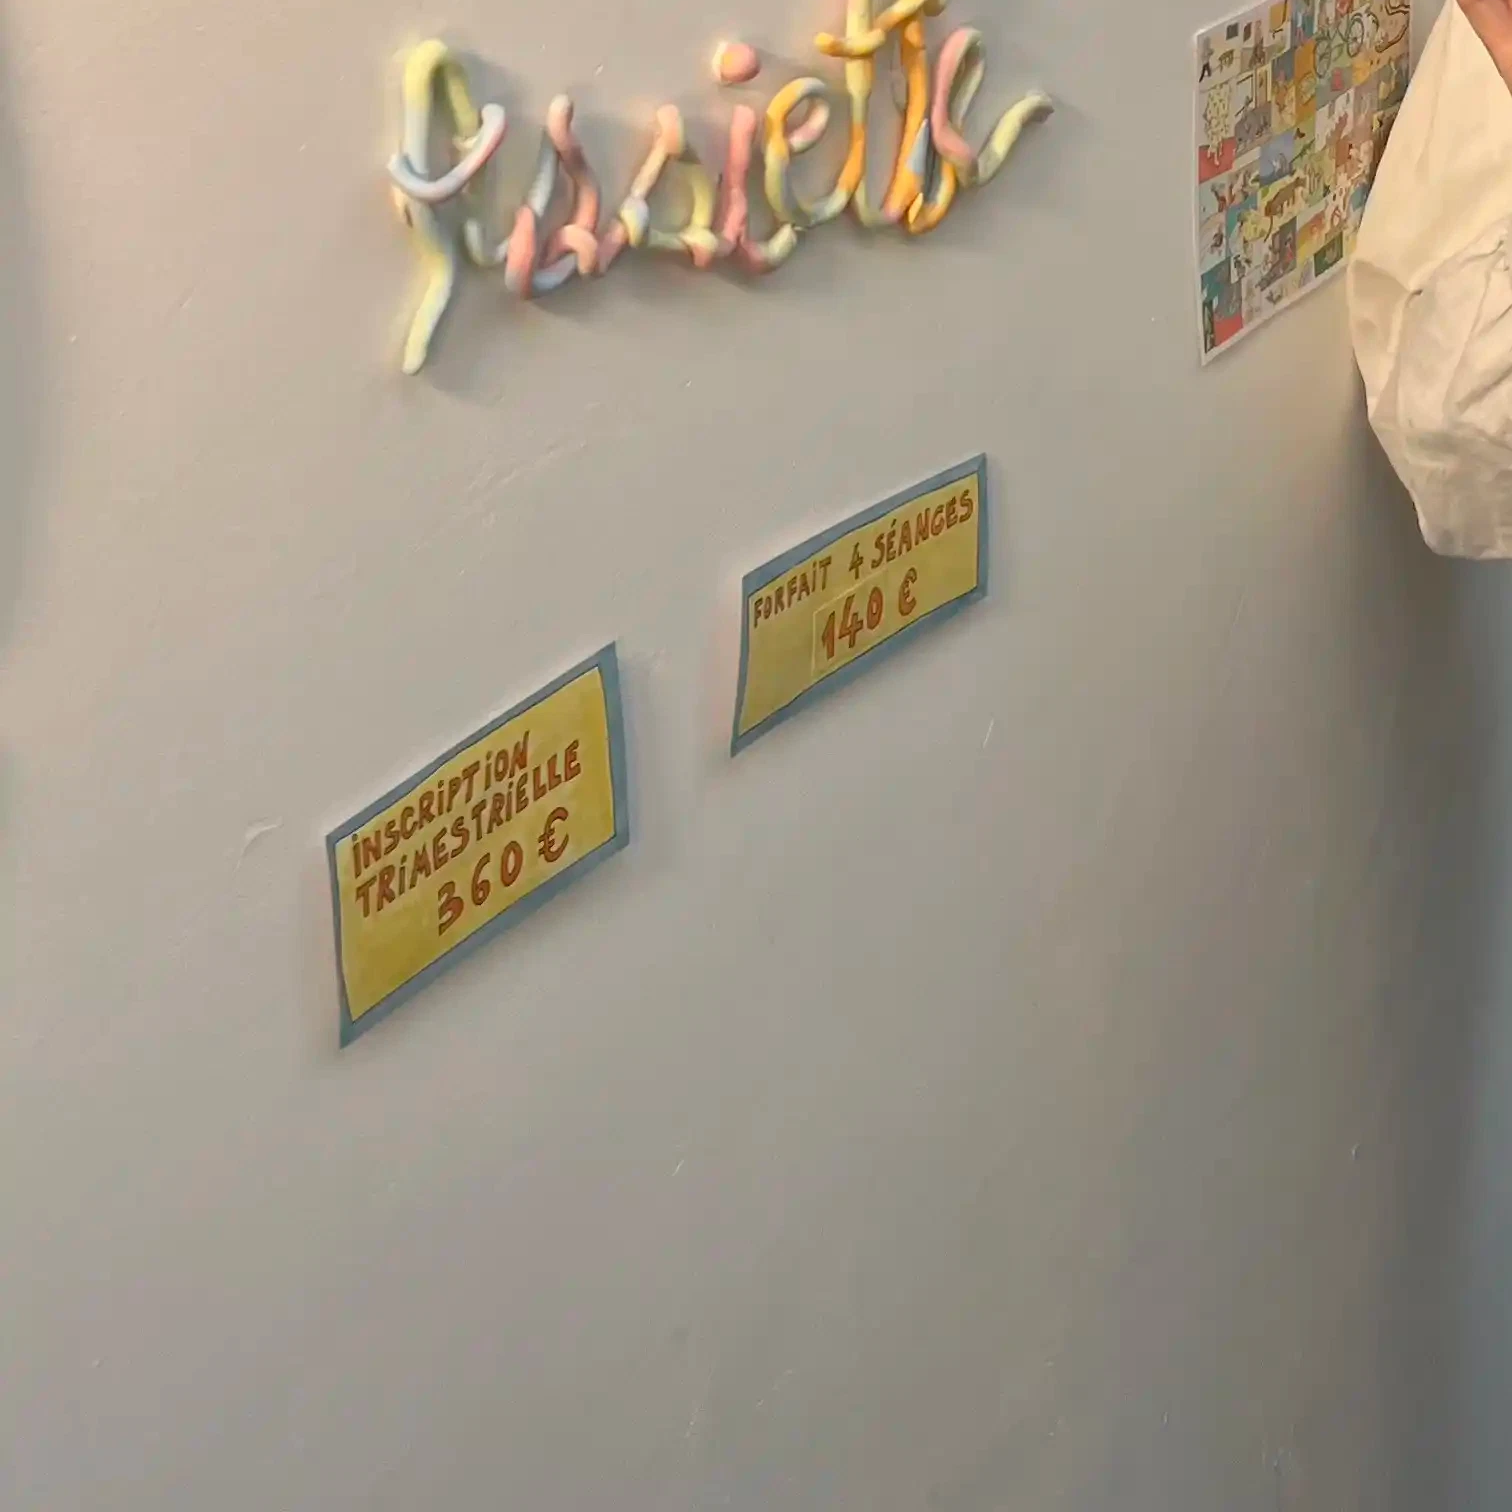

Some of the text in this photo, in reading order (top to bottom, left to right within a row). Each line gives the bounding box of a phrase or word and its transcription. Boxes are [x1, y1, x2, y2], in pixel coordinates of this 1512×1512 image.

[849, 542, 864, 580] 4
[821, 567, 918, 660] 140 €
[438, 806, 569, 936] 360 €
